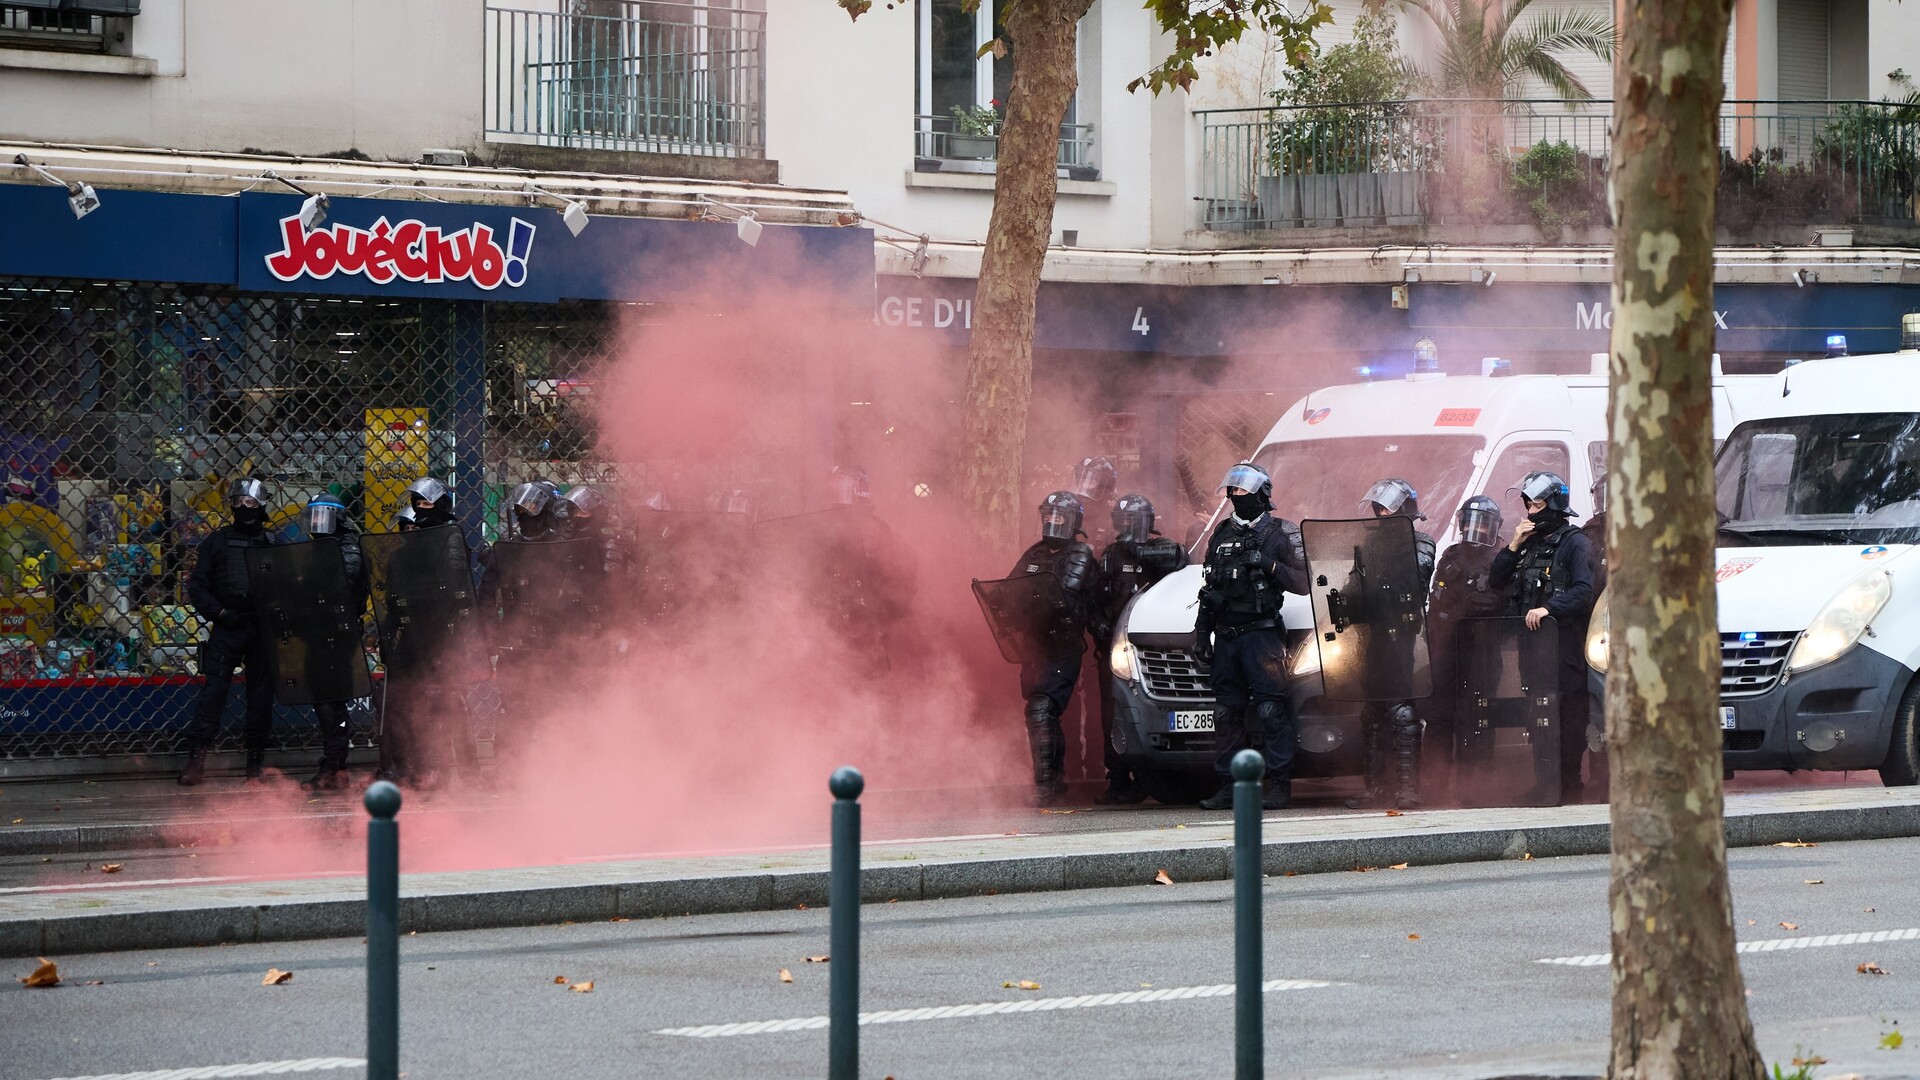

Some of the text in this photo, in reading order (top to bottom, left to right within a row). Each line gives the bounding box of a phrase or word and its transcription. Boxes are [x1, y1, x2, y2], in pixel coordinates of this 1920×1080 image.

[265, 215, 537, 290] JouéClub!
[1131, 307, 1150, 336] 4
[1439, 412, 1477, 423] 82/33
[1176, 713, 1214, 730] EC-285
